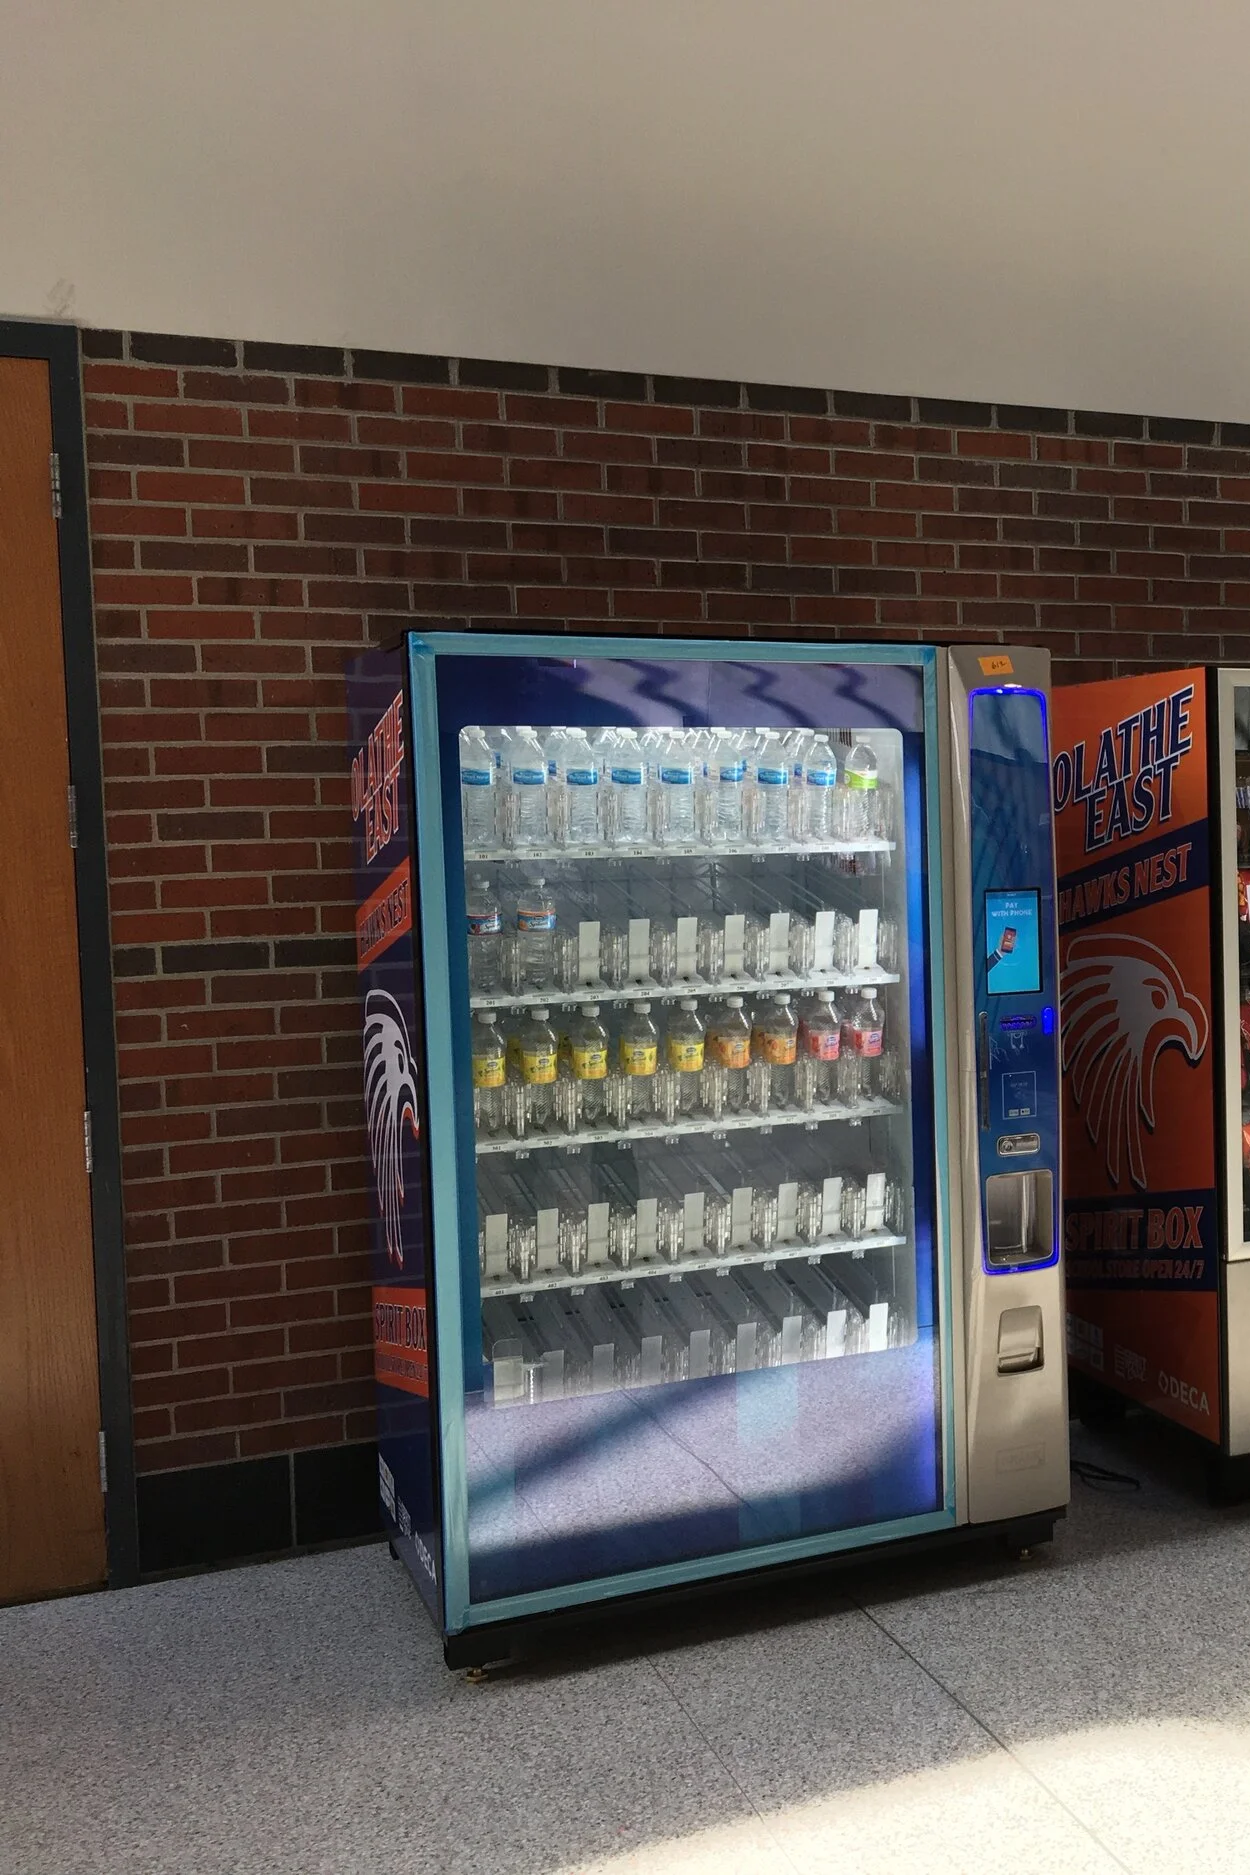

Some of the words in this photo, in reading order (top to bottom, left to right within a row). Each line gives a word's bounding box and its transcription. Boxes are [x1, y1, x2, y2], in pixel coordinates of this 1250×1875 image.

[351, 688, 404, 821] OLATHE
[1053, 683, 1195, 813] OLATHE
[365, 769, 400, 865] EAST
[1085, 752, 1182, 853] EAST
[991, 910, 1009, 918] WITH
[1010, 909, 1033, 917] PHONE
[1058, 865, 1132, 925] HAWKS
[1133, 842, 1193, 899] NEST
[1065, 1208, 1145, 1252] SPIRIT
[1146, 1205, 1206, 1251] BOX
[1142, 1259, 1174, 1279] OPEN
[1173, 1259, 1206, 1281] 24/7
[375, 1302, 404, 1347] SPIRIT
[405, 1305, 428, 1352] BOX
[1170, 1375, 1211, 1416] DECA
